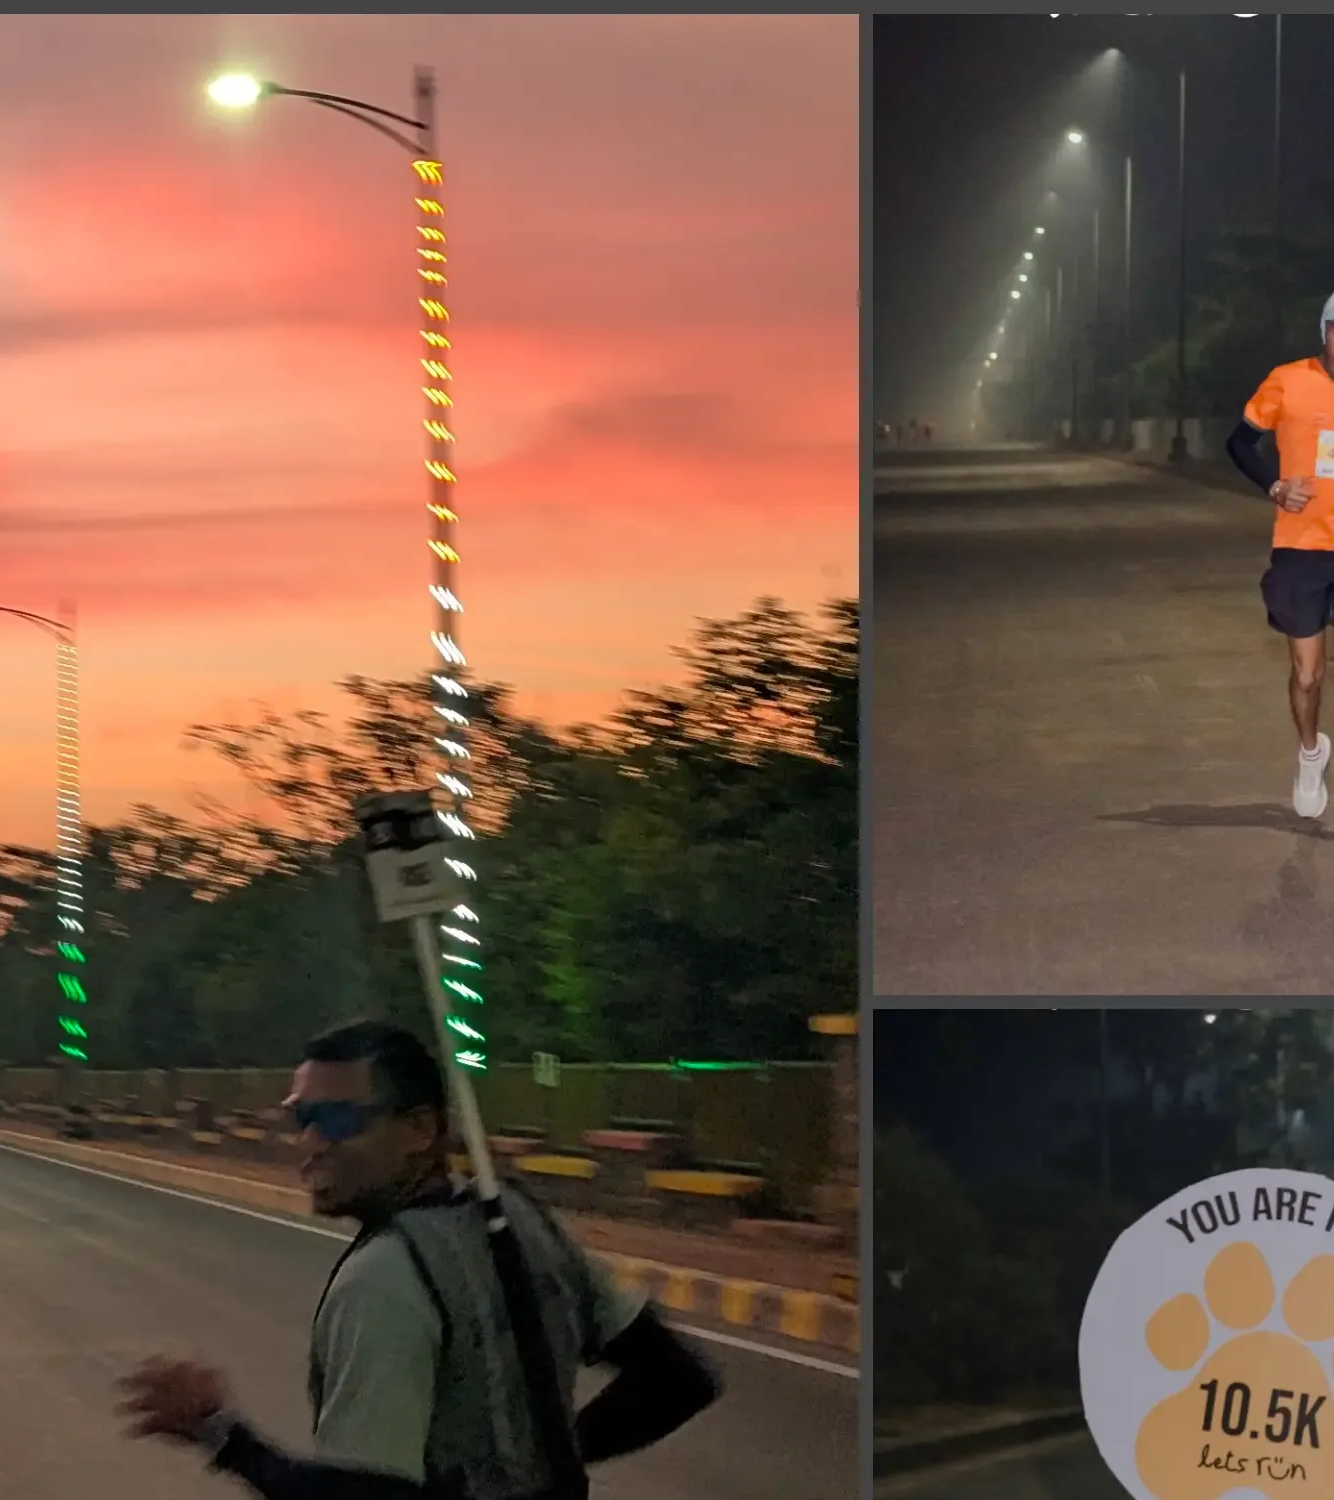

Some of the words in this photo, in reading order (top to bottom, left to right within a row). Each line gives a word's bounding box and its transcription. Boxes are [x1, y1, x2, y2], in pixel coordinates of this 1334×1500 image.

[1166, 1191, 1241, 1243] YOU
[1252, 1187, 1323, 1226] ARE
[1199, 1378, 1327, 1448] 10.5K
[1197, 1443, 1249, 1473] lets
